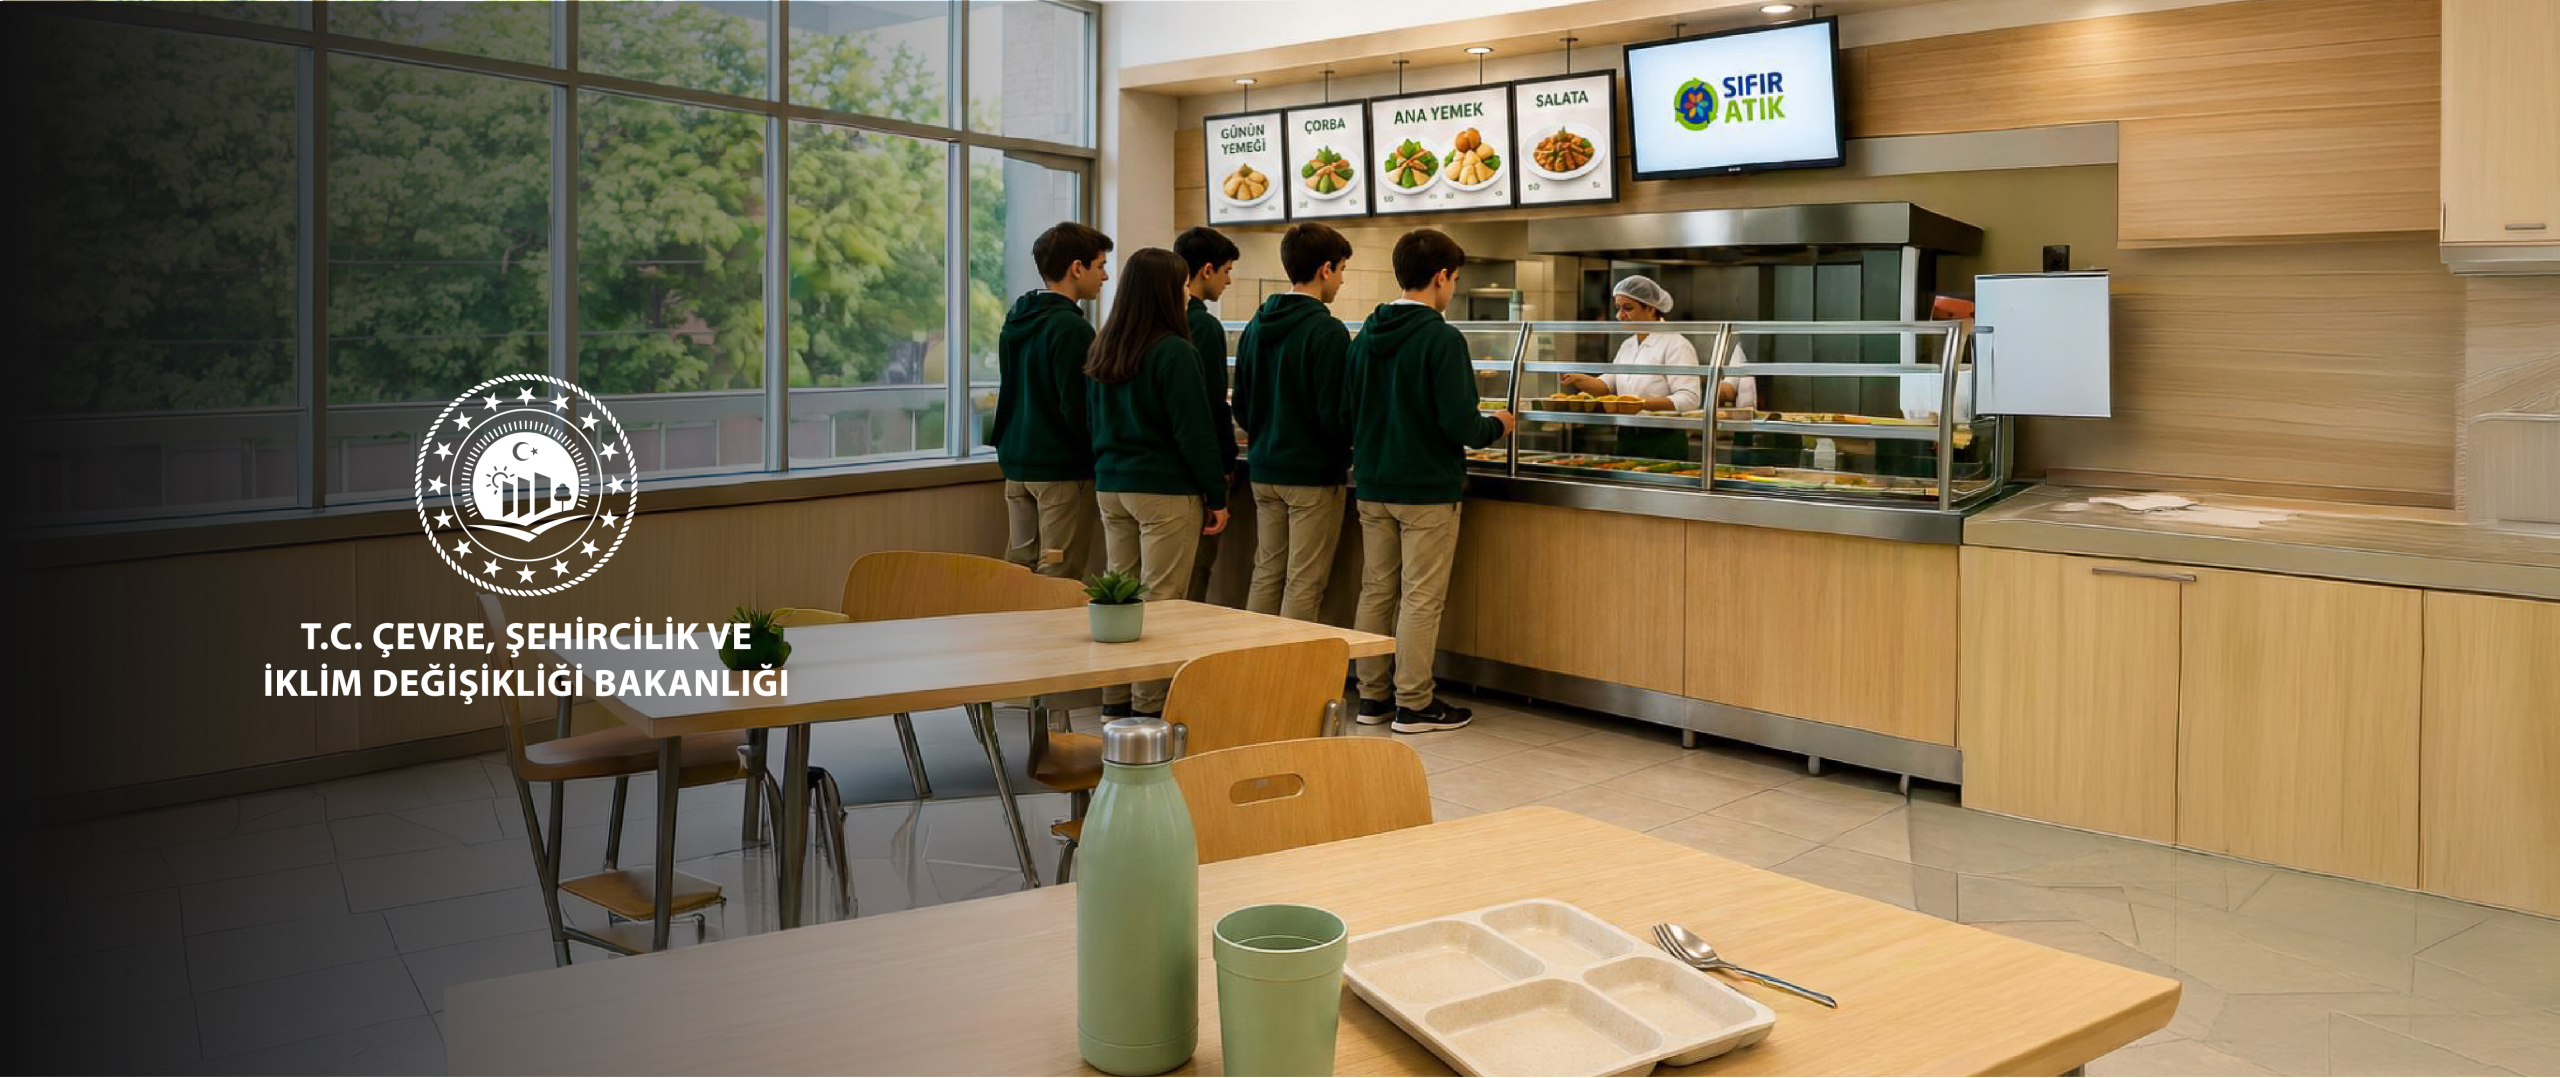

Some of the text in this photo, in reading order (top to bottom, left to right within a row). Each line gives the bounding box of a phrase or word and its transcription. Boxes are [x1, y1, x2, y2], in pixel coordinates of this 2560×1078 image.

[1723, 71, 1784, 99] SIFIR
[1535, 90, 1589, 108] SALATA
[1394, 102, 1484, 125] ANA YEMEK
[1725, 95, 1786, 124] ATIK
[1220, 123, 1265, 139] GÜNÜN
[1304, 117, 1346, 135] ÇORBA
[1221, 138, 1267, 155] YEMEĞİ
